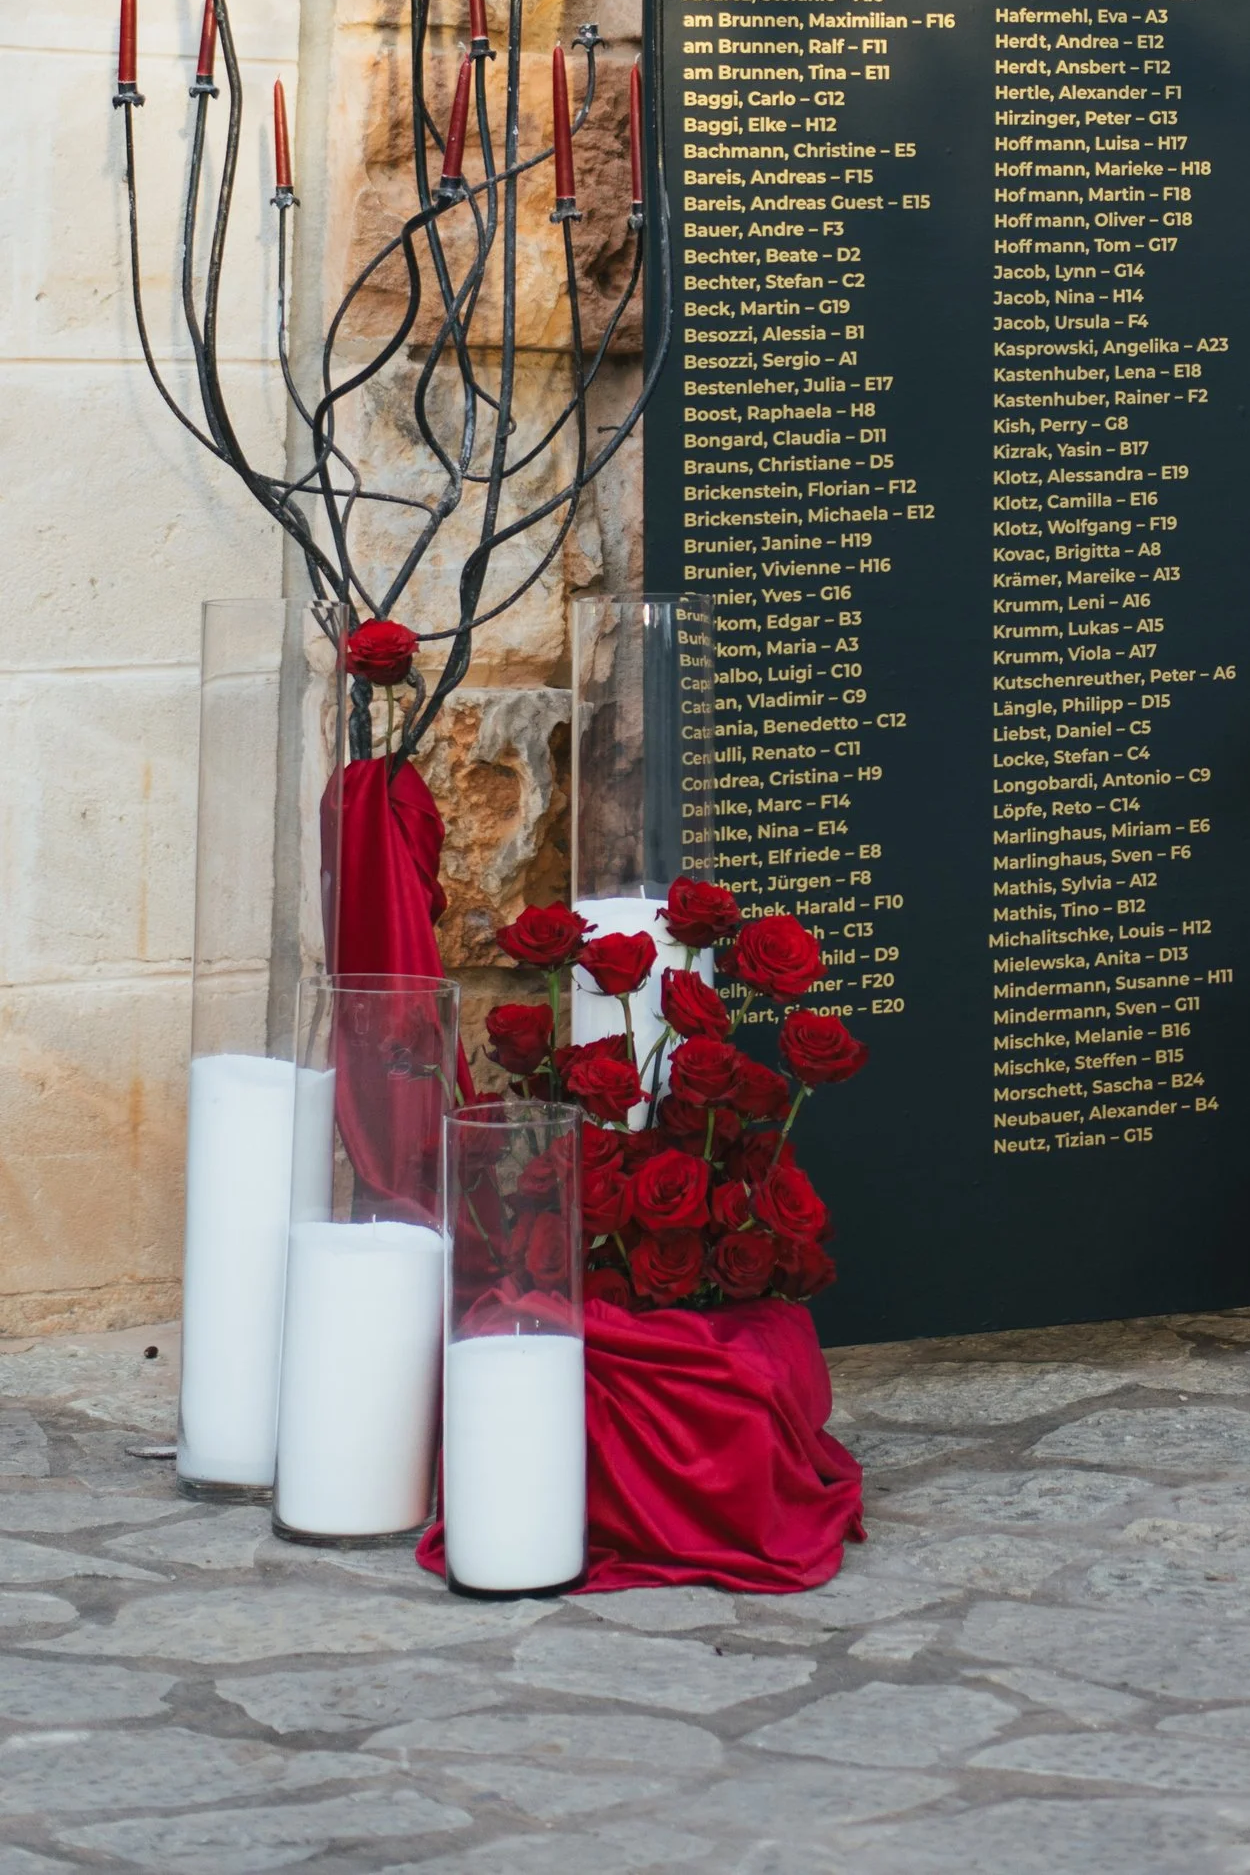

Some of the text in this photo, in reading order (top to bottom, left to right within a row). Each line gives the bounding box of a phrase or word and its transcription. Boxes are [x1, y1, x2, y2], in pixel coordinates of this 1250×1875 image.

[684, 15, 713, 27] am
[718, 12, 804, 30] Brunnen,
[809, 11, 908, 28] Maximilian
[926, 13, 956, 28] F16
[995, 59, 1052, 77] Herdt,
[1055, 59, 1126, 74] Ansbert
[1144, 60, 1171, 74] F12
[684, 90, 744, 109] Baggi,
[748, 90, 796, 106] Carlo
[814, 91, 845, 106] G12
[995, 109, 1081, 129] Hirzinger,
[1085, 111, 1132, 125] Peter
[1149, 110, 1178, 125] G13
[684, 143, 789, 161] Bachmann,
[793, 141, 876, 158] Christine
[895, 142, 916, 158] E5
[684, 194, 746, 214] Bareis,
[750, 195, 827, 211] Andreas
[831, 195, 884, 210] Guest
[902, 194, 931, 209] E15
[684, 248, 761, 266] Bechter,
[766, 248, 818, 263] Beate
[837, 247, 861, 262] D2
[993, 289, 1050, 307] Jacob,
[1055, 288, 1094, 304] Nina
[1113, 288, 1145, 303] H14
[684, 300, 736, 319] Beck,
[741, 299, 800, 316] Martin
[819, 299, 850, 314] G19
[994, 339, 1098, 359] Kasprowski,
[1102, 338, 1179, 357] Angelika
[1196, 337, 1229, 352] A23
[684, 378, 799, 396] Bestenleher,
[803, 376, 846, 393] Julia
[865, 376, 894, 391] E17
[684, 431, 768, 451] Bongard,
[773, 428, 841, 446] Claudia
[860, 428, 886, 443] D11
[993, 469, 1043, 486] Klotz,
[1047, 466, 1143, 483] Alessandra
[1161, 465, 1189, 480] E19
[684, 482, 803, 501] Brickenstein,
[808, 480, 870, 497] Florian
[889, 479, 917, 494] F12
[684, 536, 757, 554] Brunier,
[761, 534, 822, 551] Janine
[841, 532, 872, 548] H19
[993, 670, 1145, 691] Kutschenreuther,
[1150, 669, 1196, 683] Peter
[1213, 665, 1236, 680] A6
[993, 772, 1098, 795] Longobardi,
[1102, 769, 1172, 788] Antonio
[1189, 768, 1211, 783] C9
[993, 903, 1057, 922] Mathis,
[1061, 901, 1099, 918] Tino
[1117, 898, 1146, 914] B12
[994, 1137, 1050, 1154] Neutz,
[1054, 1131, 1106, 1148] Tizian
[1124, 1127, 1153, 1143] G15
